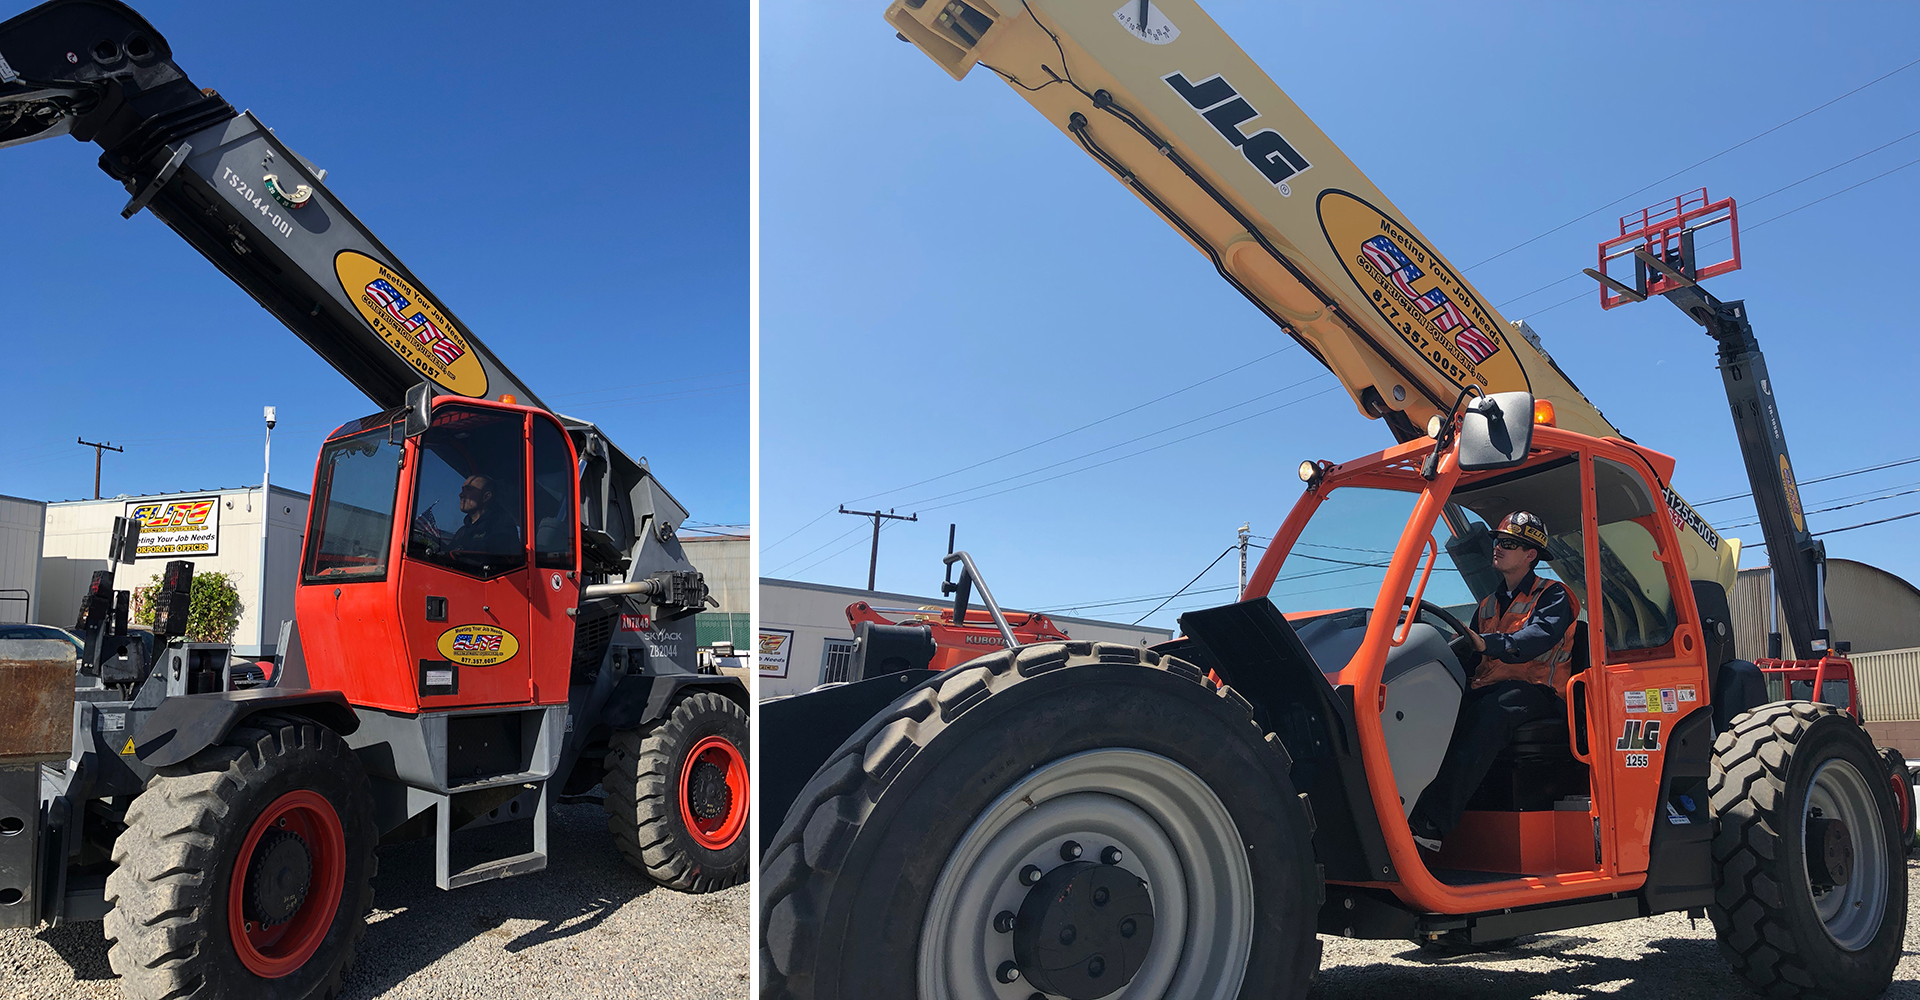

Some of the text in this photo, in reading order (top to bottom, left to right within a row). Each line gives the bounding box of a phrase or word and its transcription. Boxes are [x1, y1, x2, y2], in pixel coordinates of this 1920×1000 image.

[1161, 70, 1313, 187] JLG
[222, 166, 294, 238] TS2044-001
[378, 266, 466, 350] Meeting Your Job Needs
[1361, 234, 1500, 366] ELITE
[1380, 219, 1500, 346] Meeting Your Job Needs
[361, 294, 411, 342] CONSTRUCTION
[365, 278, 466, 366] ELITE
[1356, 254, 1426, 326] CONSTRUCTION
[1425, 322, 1477, 377] EQUIPMENT,
[1372, 288, 1467, 382] 877.357.0057
[372, 318, 440, 378] 877.357.0057
[130, 500, 215, 527] ELITE
[138, 536, 155, 544] ting
[136, 543, 209, 554] ORPORATE OFFICES
[453, 634, 503, 651] ELITE
[644, 628, 682, 642] SKYJACK
[650, 644, 678, 657] ZB2044
[1616, 719, 1660, 751] JLG
[1626, 754, 1648, 768] 1255
